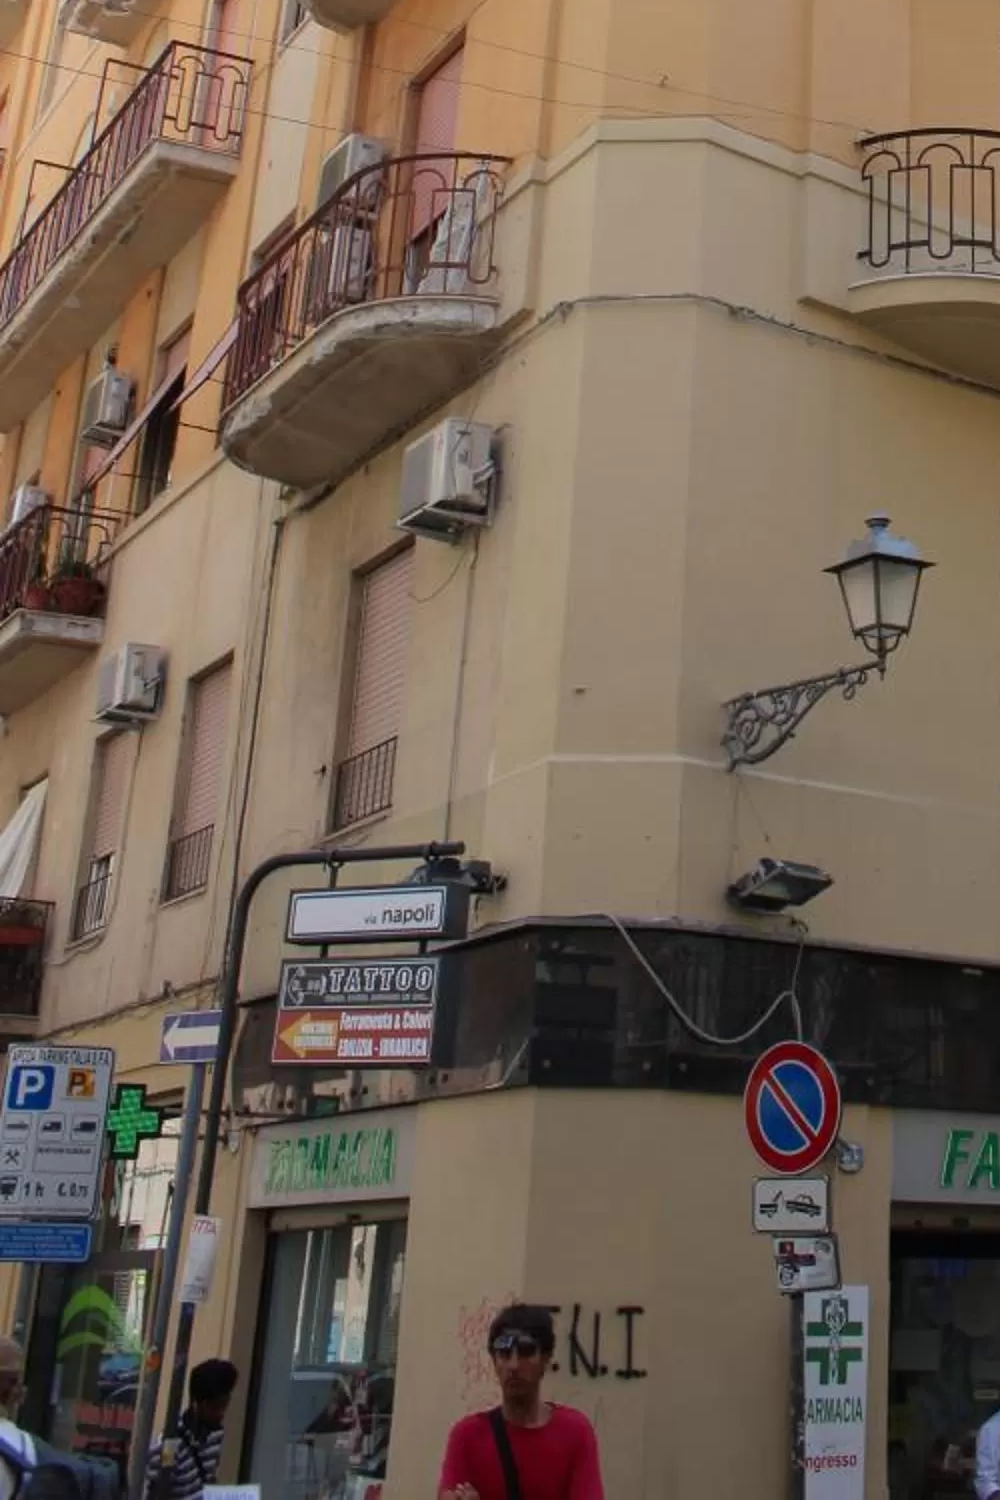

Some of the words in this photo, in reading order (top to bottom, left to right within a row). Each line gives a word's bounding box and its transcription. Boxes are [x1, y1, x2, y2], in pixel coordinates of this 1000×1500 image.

[381, 902, 436, 926] napoli
[328, 965, 433, 993] TATTOO
[16, 1068, 46, 1106] P
[265, 1128, 397, 1193] FARMACIA
[803, 1396, 863, 1424] ARMACIA
[803, 1453, 858, 1473] ngresso
